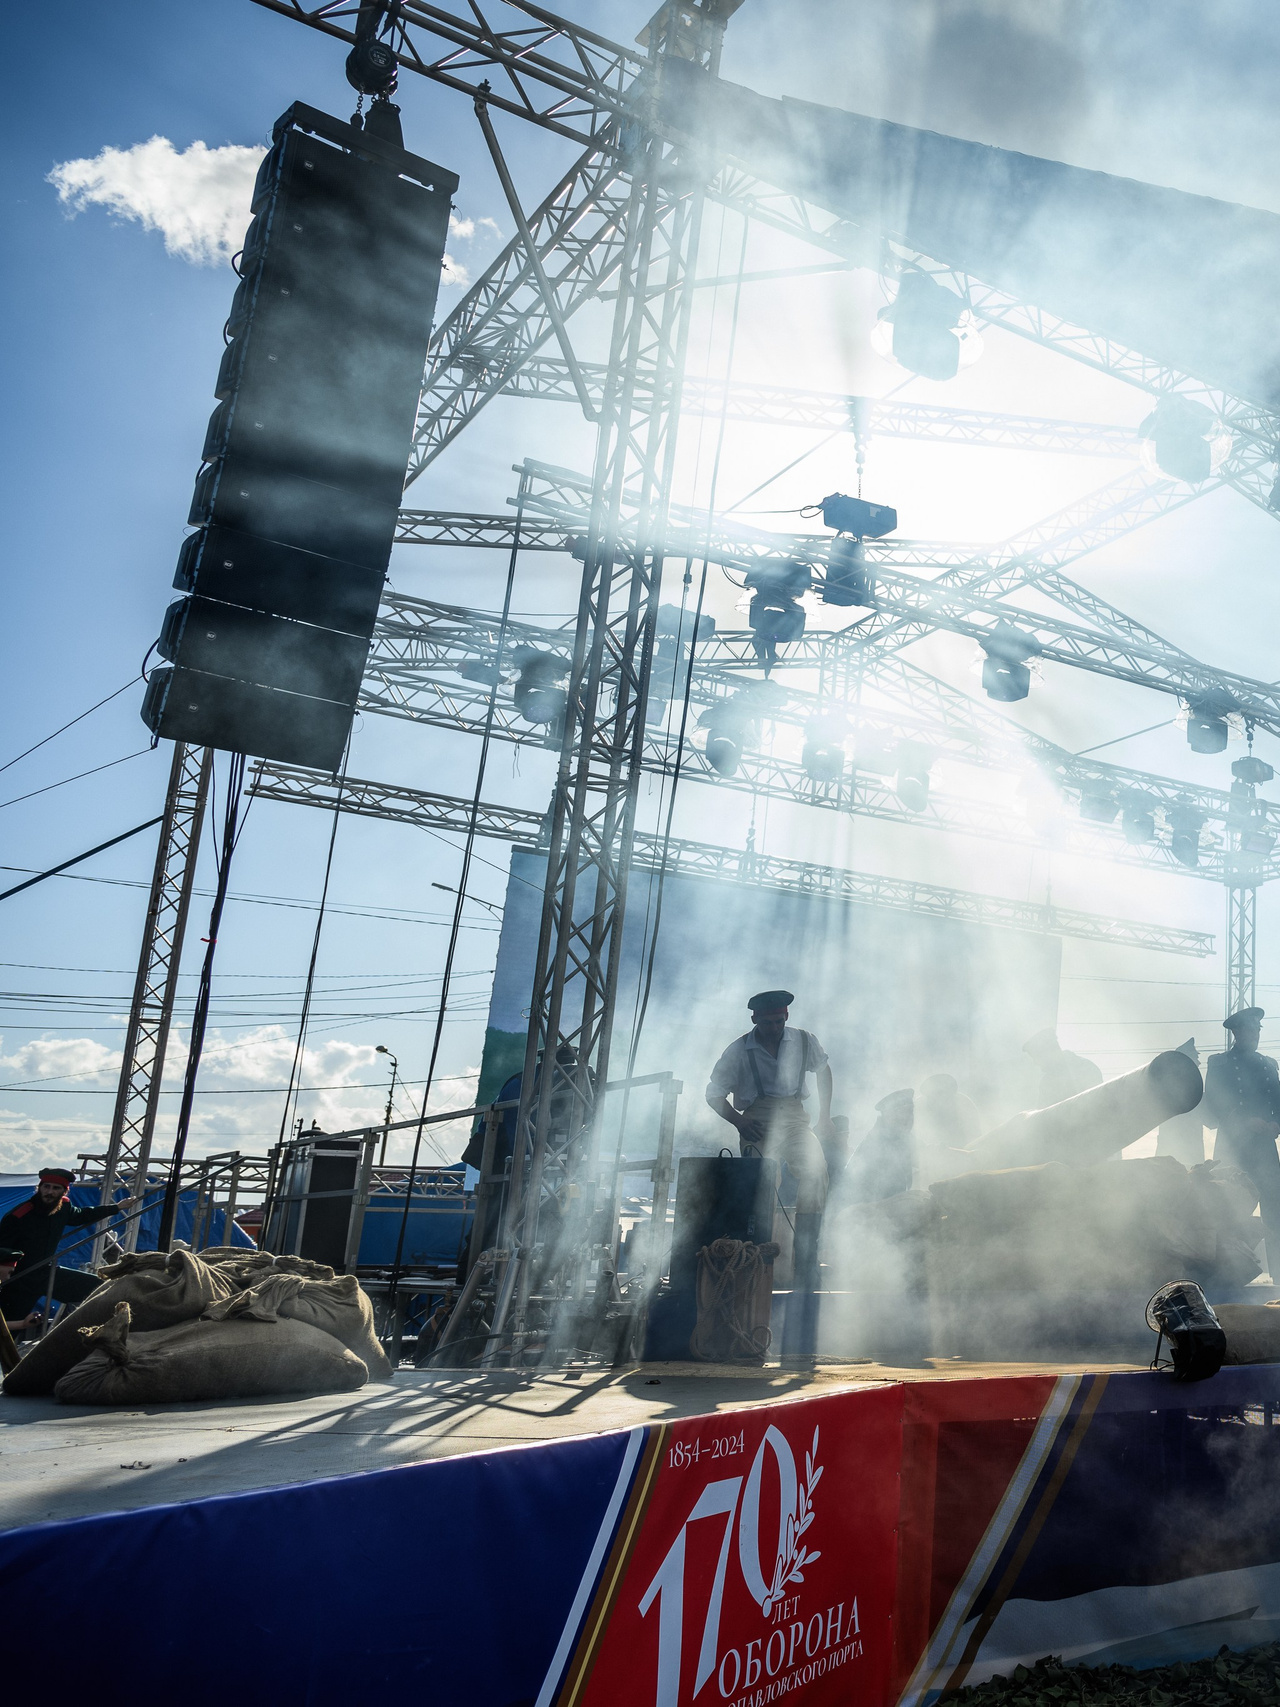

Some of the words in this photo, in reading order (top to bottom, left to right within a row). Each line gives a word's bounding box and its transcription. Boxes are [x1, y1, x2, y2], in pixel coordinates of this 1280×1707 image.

[668, 1428, 746, 1472] 1854-2024
[637, 1423, 799, 1707] 170
[771, 1594, 801, 1626] ЛЕТ
[718, 1595, 861, 1699] ОБОРОНА
[827, 1639, 864, 1673] ПОРТА
